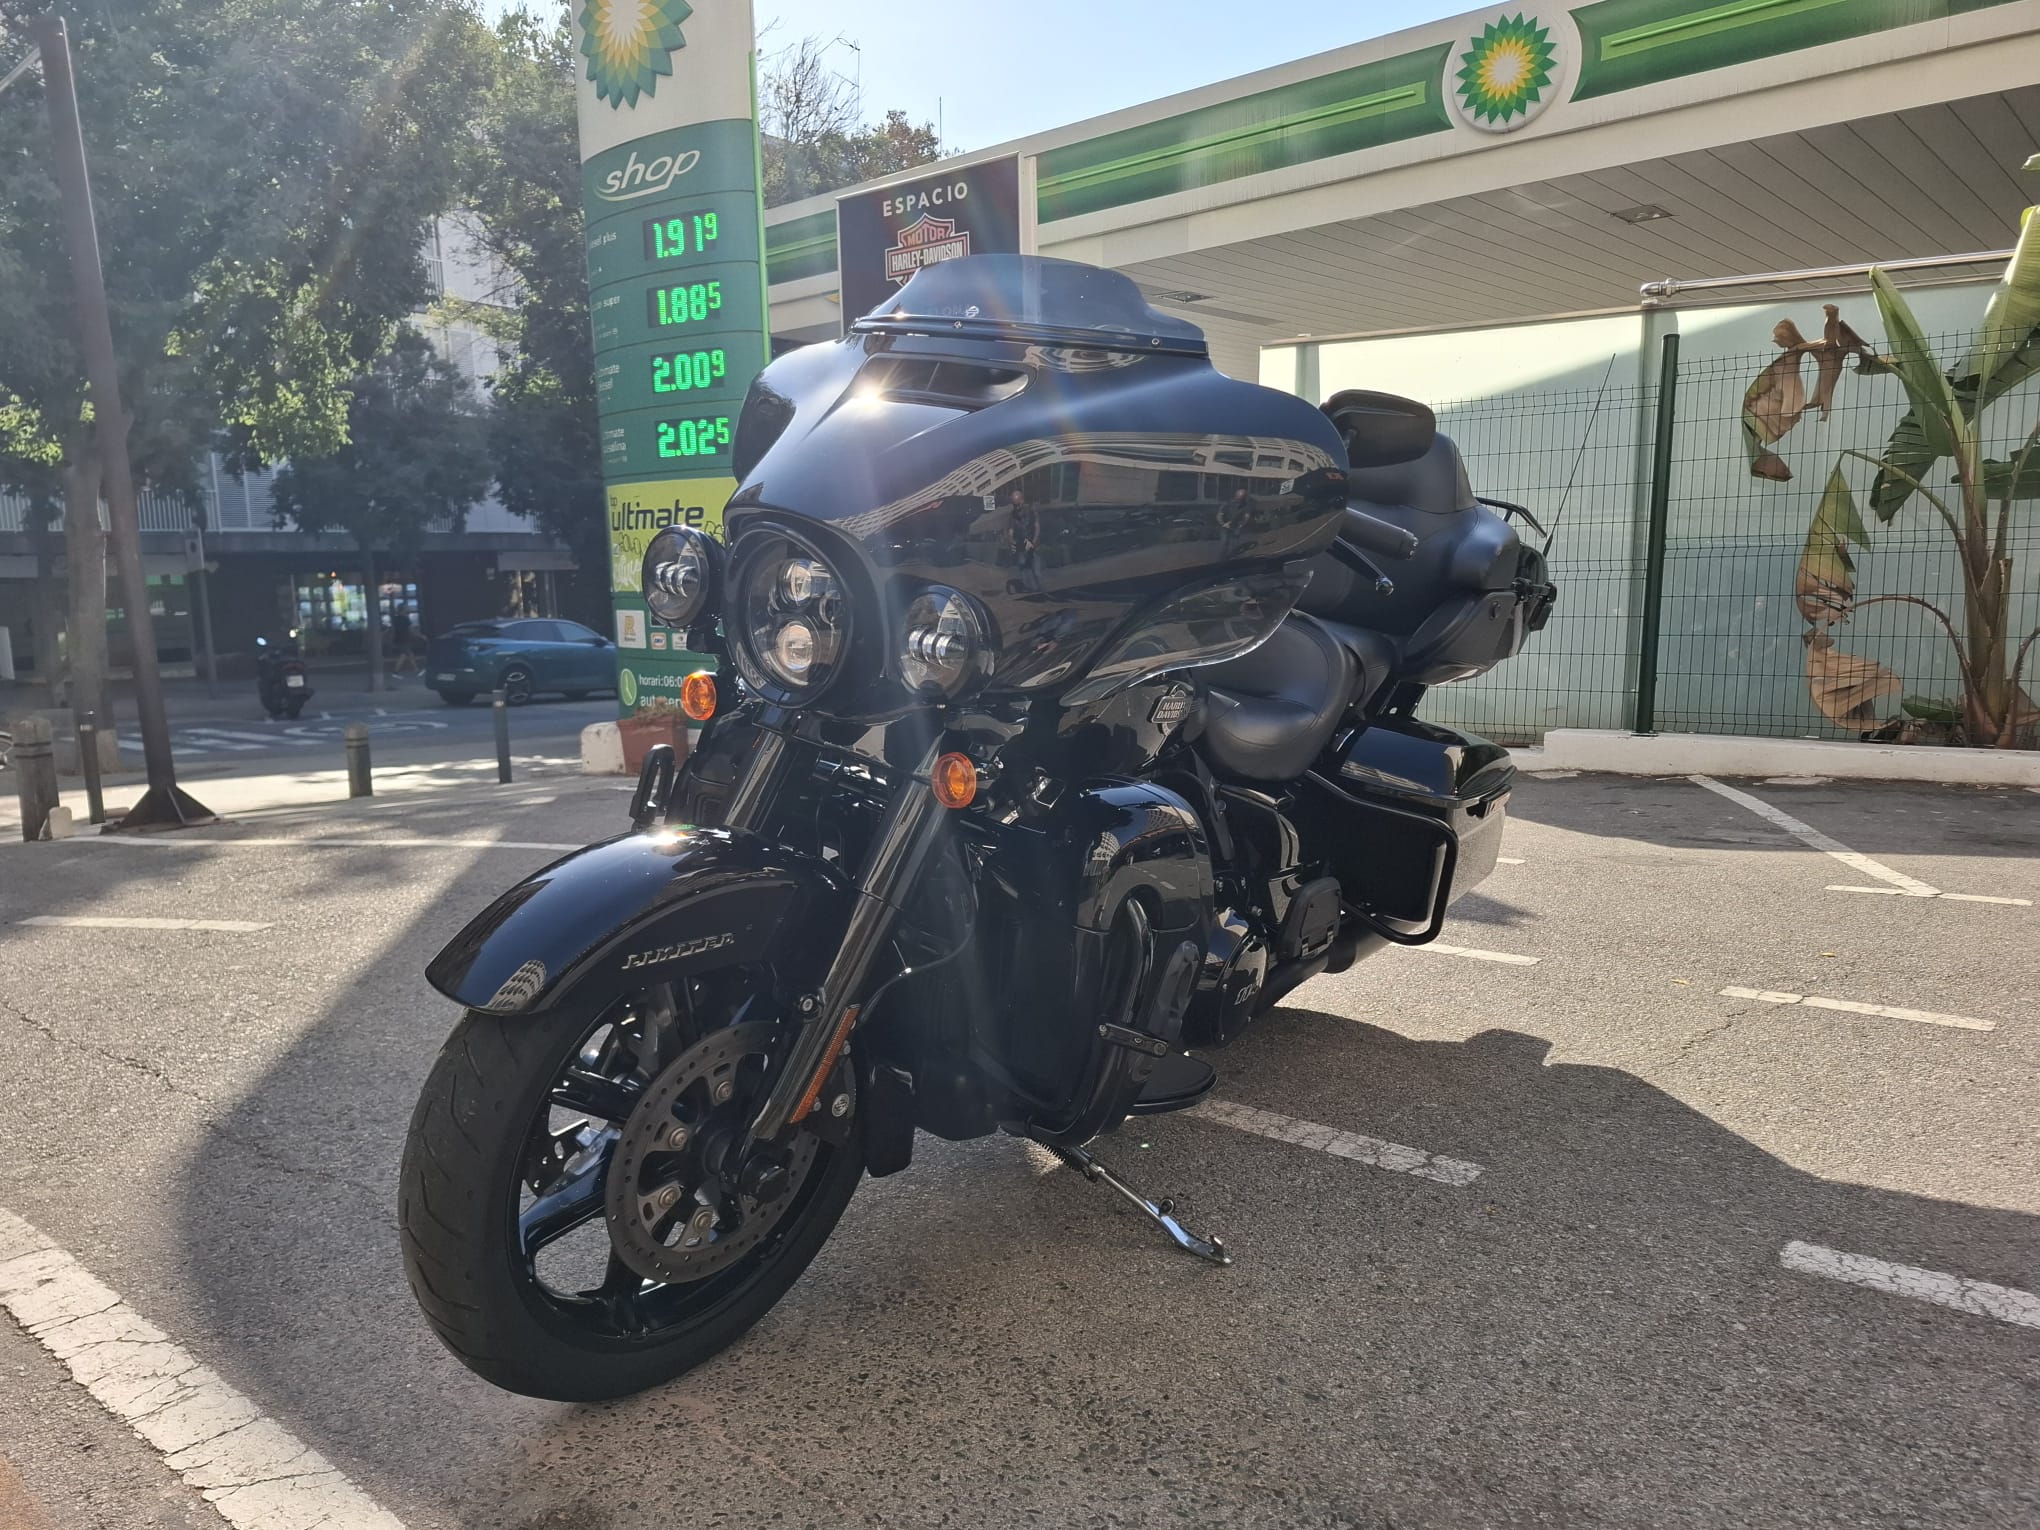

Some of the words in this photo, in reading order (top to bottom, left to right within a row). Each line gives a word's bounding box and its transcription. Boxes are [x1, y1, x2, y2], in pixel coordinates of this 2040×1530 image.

[600, 150, 700, 196] shop
[882, 182, 969, 217] ESPACIO
[906, 224, 945, 246] MOTOR
[891, 241, 963, 272] HARLEY-DAVIDSON
[656, 281, 721, 325] 1.885
[653, 349, 725, 393] 2.009
[657, 417, 729, 458] 2.025
[611, 499, 704, 532] ultimate
